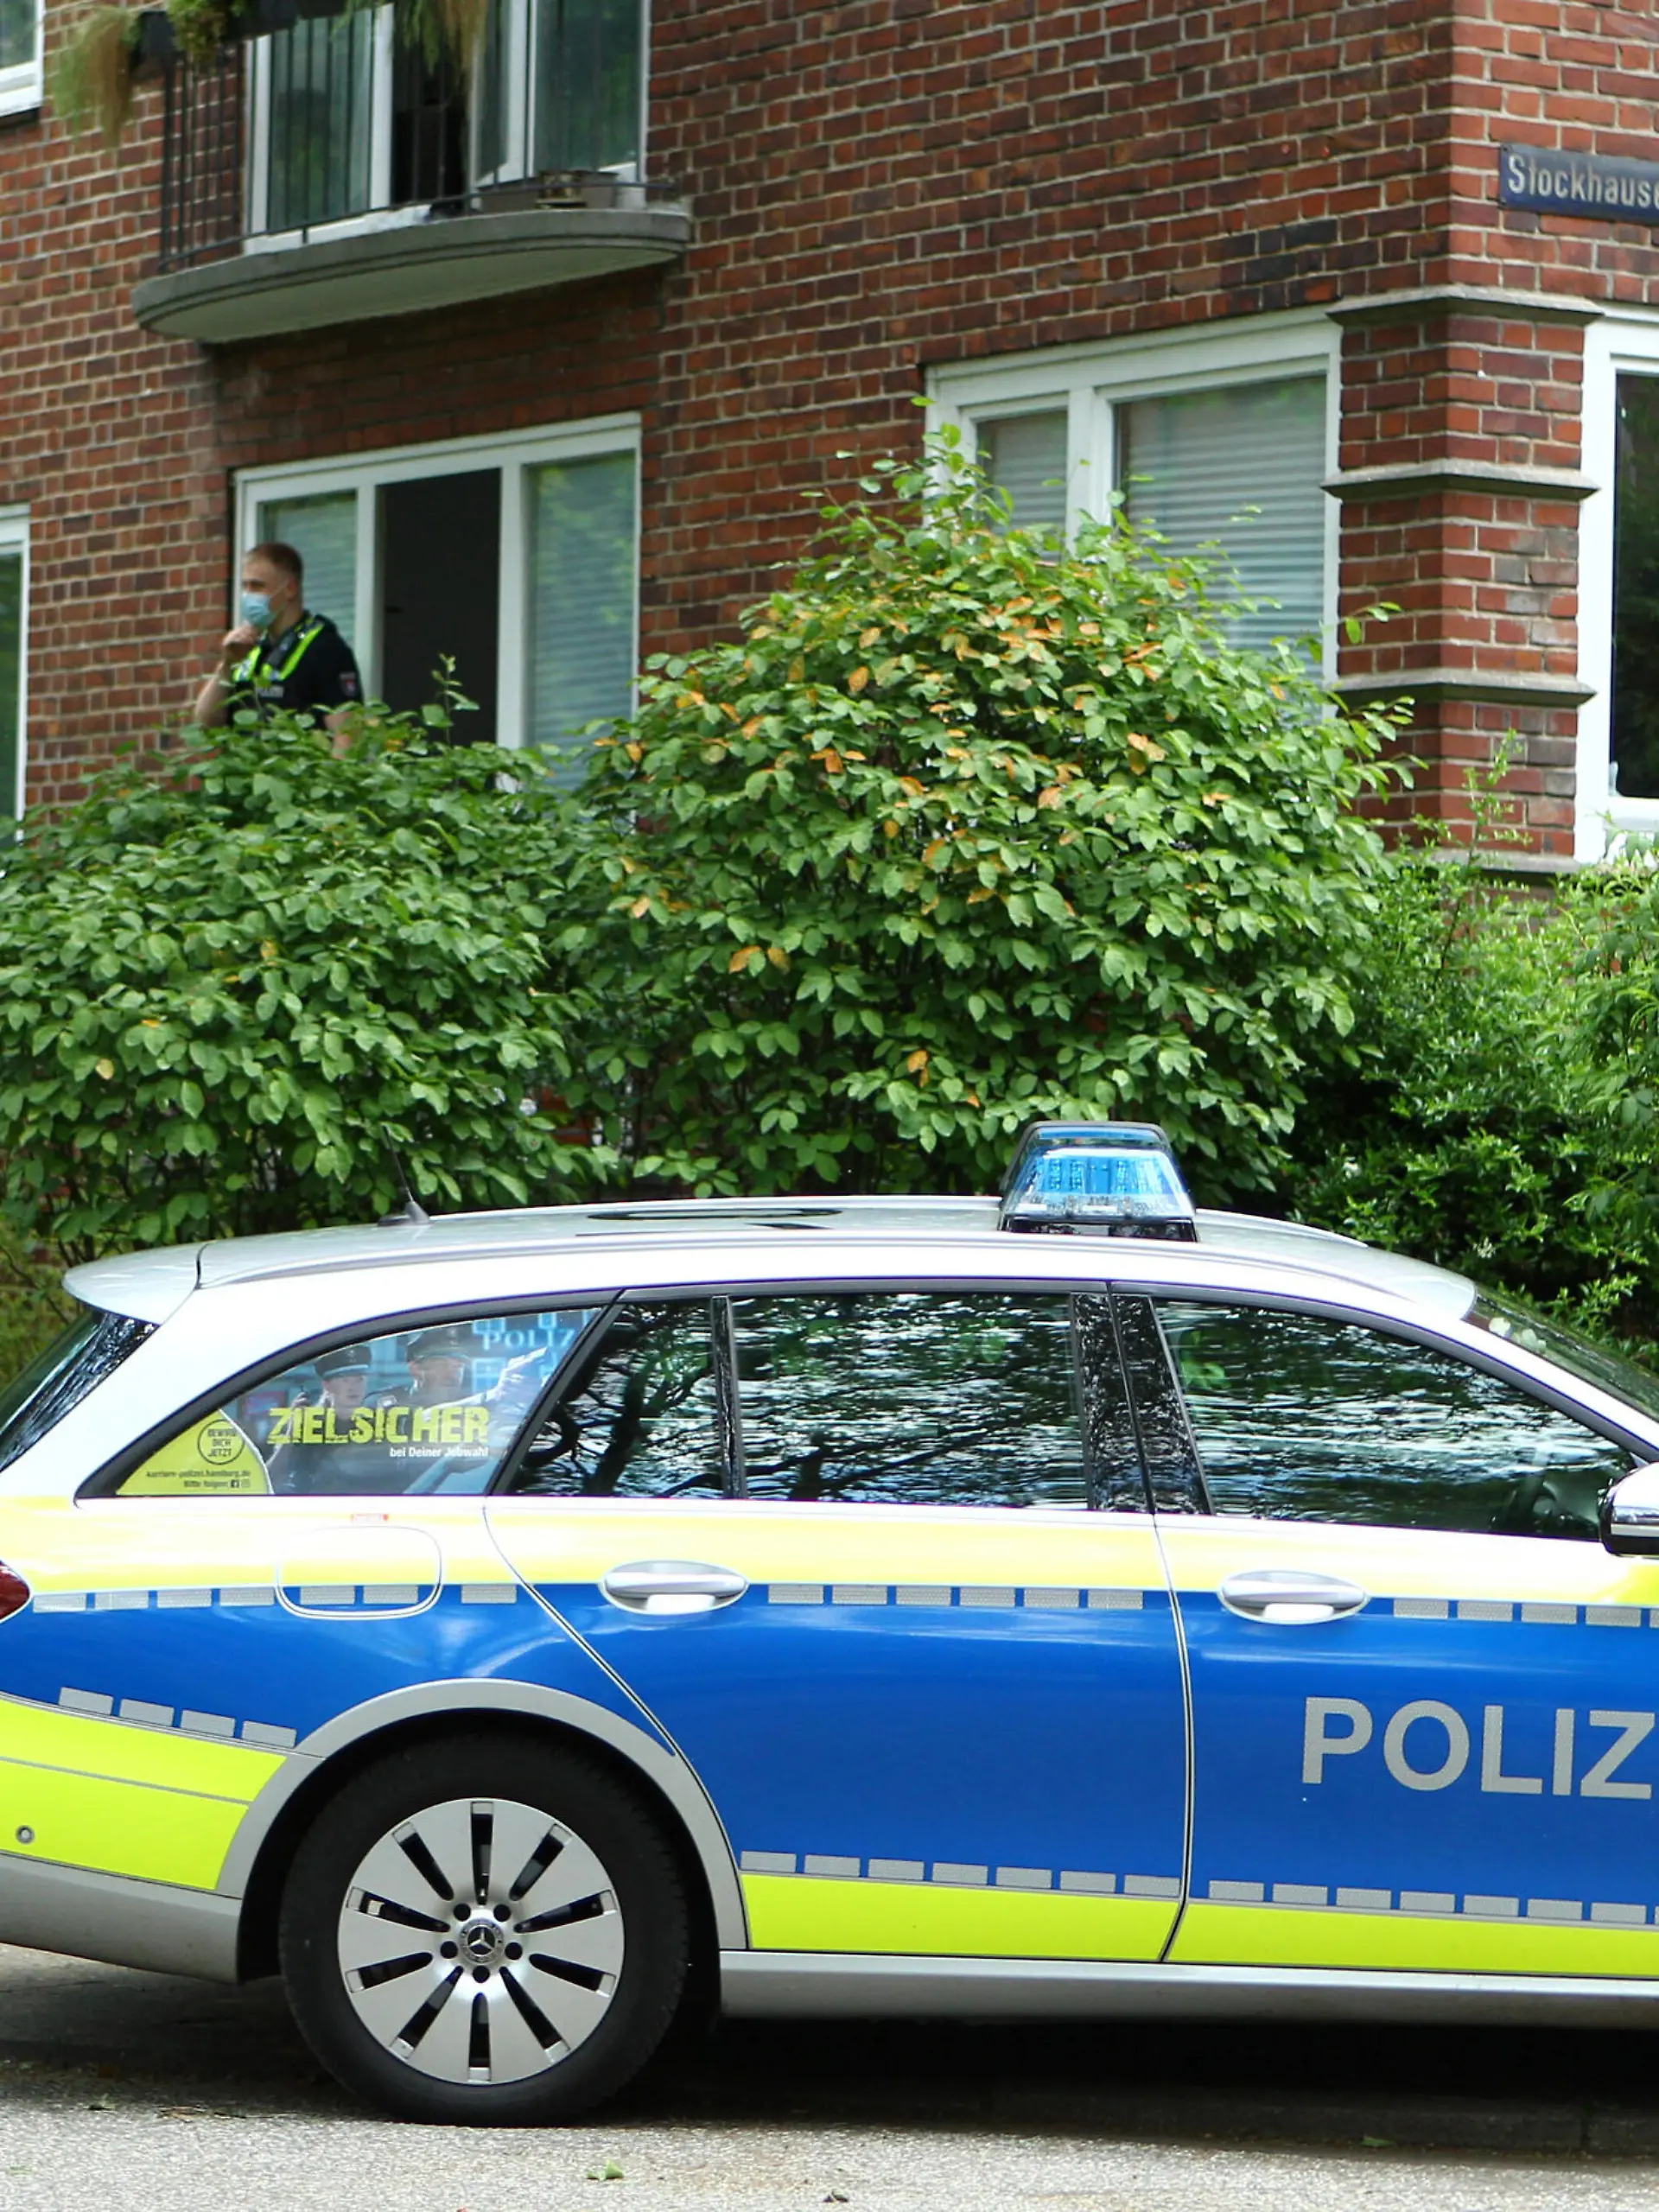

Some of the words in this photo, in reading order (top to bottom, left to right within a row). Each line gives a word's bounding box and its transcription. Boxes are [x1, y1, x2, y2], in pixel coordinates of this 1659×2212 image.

[266, 1407, 489, 1444] ZIELSICHER
[207, 1448, 232, 1457] JETZT
[390, 1446, 406, 1457] bei
[409, 1446, 441, 1457] Deiner
[1302, 1696, 1656, 1800] POLIZ
